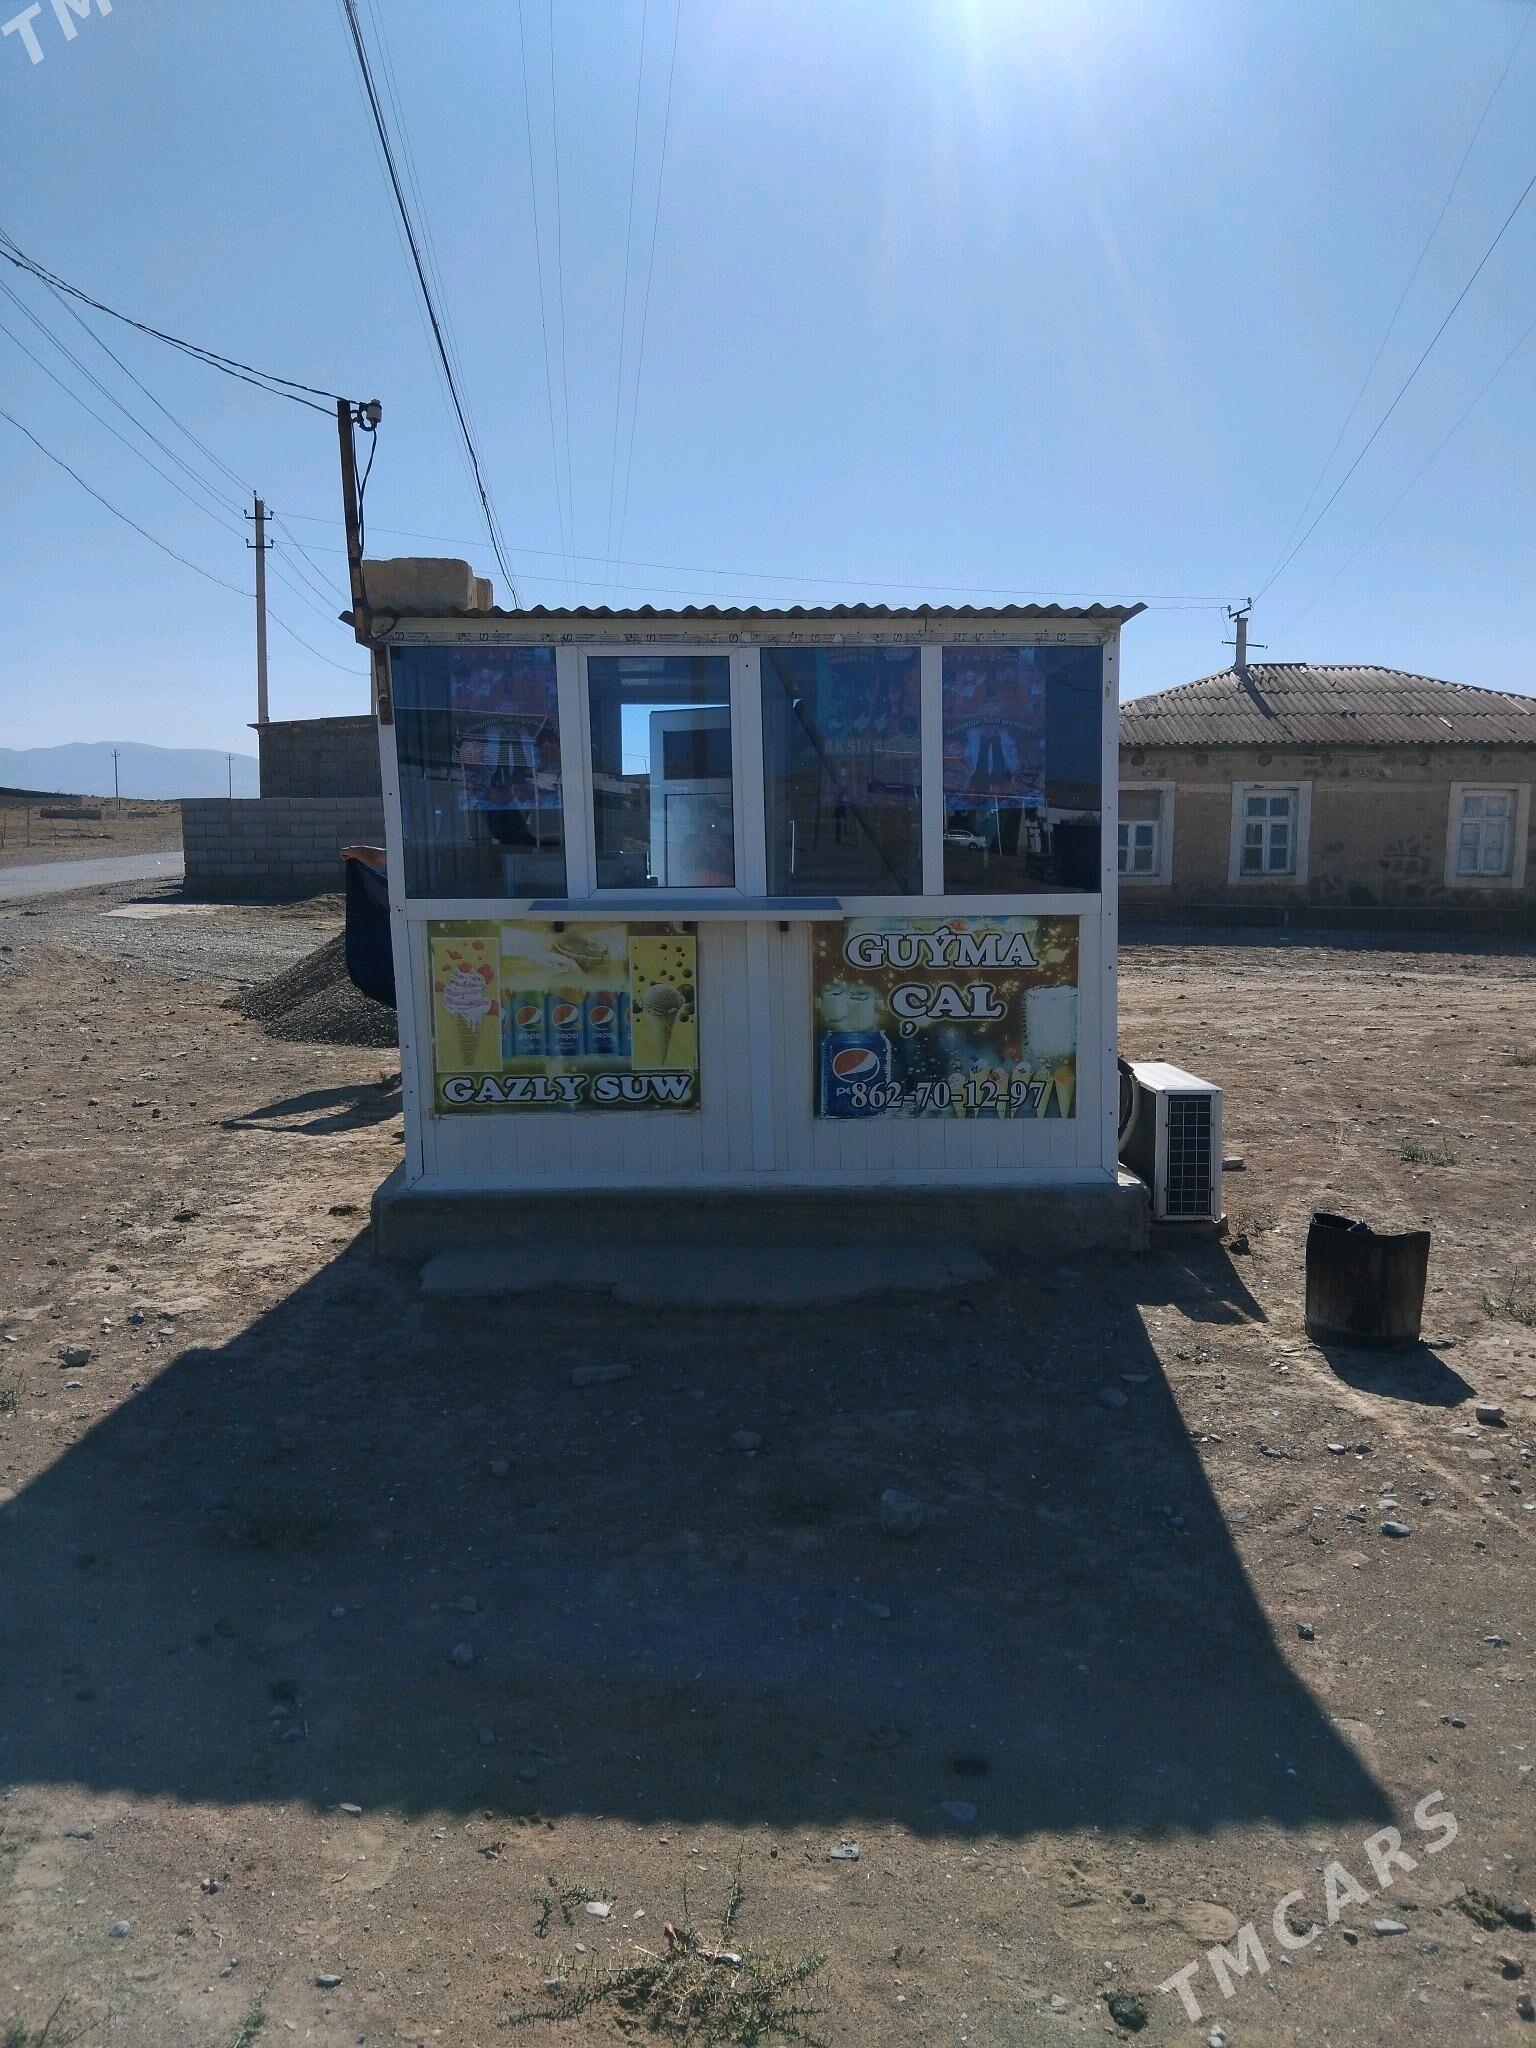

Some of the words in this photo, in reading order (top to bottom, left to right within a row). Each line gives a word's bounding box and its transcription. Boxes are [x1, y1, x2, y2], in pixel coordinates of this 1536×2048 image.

[846, 926, 1038, 968] GUÝMA
[554, 1031, 579, 1041] pepsi
[443, 1075, 586, 1102] GAZLY
[593, 1074, 691, 1102] SUW
[850, 1081, 1046, 1109] 862-70-12-97
